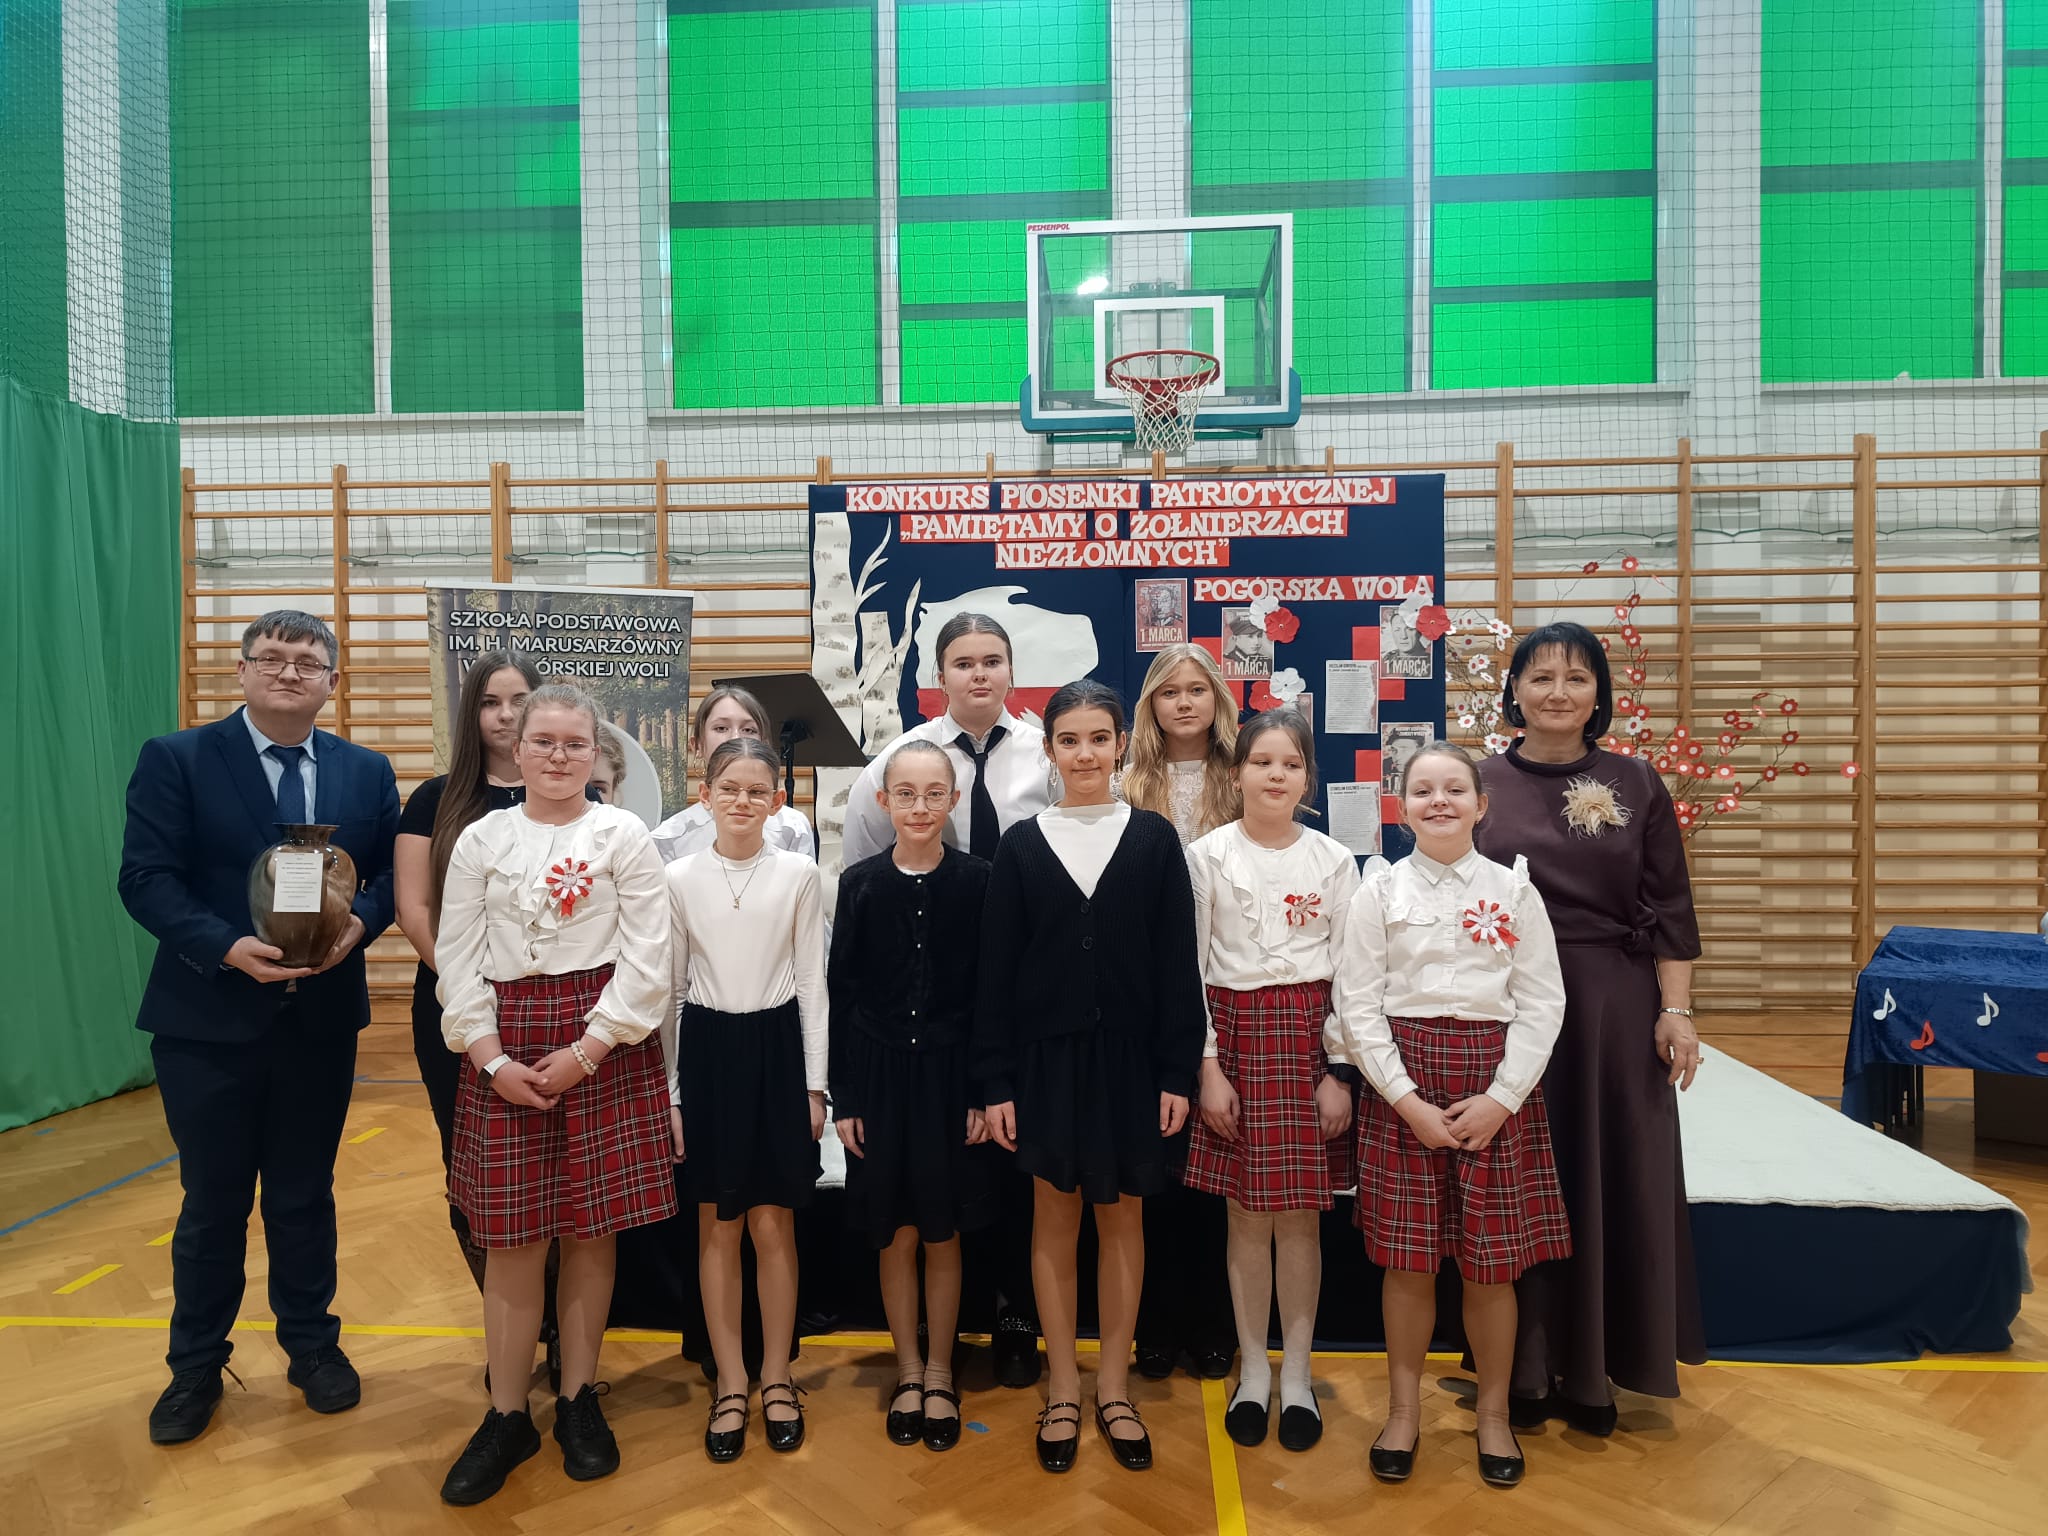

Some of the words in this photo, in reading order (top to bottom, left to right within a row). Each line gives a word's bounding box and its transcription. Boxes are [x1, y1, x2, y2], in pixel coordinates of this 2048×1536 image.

[846, 486, 989, 511] KONKURS
[1001, 483, 1140, 509] PIOSENKI
[1151, 477, 1392, 508] PATRIOTYCZNEJ
[900, 512, 1086, 542] „PAMIĘTAMY
[1095, 512, 1118, 538] O
[1130, 509, 1345, 540] ŻOŁNIERZACH
[996, 538, 1229, 567] NIEZŁOMNYCH”
[1194, 577, 1344, 601] POGÓRSKA
[1352, 575, 1434, 600] WOLA
[450, 611, 532, 628] SZKOŁA
[535, 613, 682, 633] PODSTAWOWA
[448, 635, 481, 651] IM.
[486, 636, 506, 651] H.
[511, 636, 683, 655] MARUSARZÓWNY
[1140, 628, 1145, 643] 1
[1148, 627, 1183, 642] MARCA
[535, 657, 614, 677] ÓRSKIEJ
[619, 662, 669, 678] WOLI
[1226, 661, 1232, 676] 1
[1234, 661, 1269, 676] MARCA
[1384, 660, 1390, 674] 1
[1392, 660, 1429, 675] MARCA
